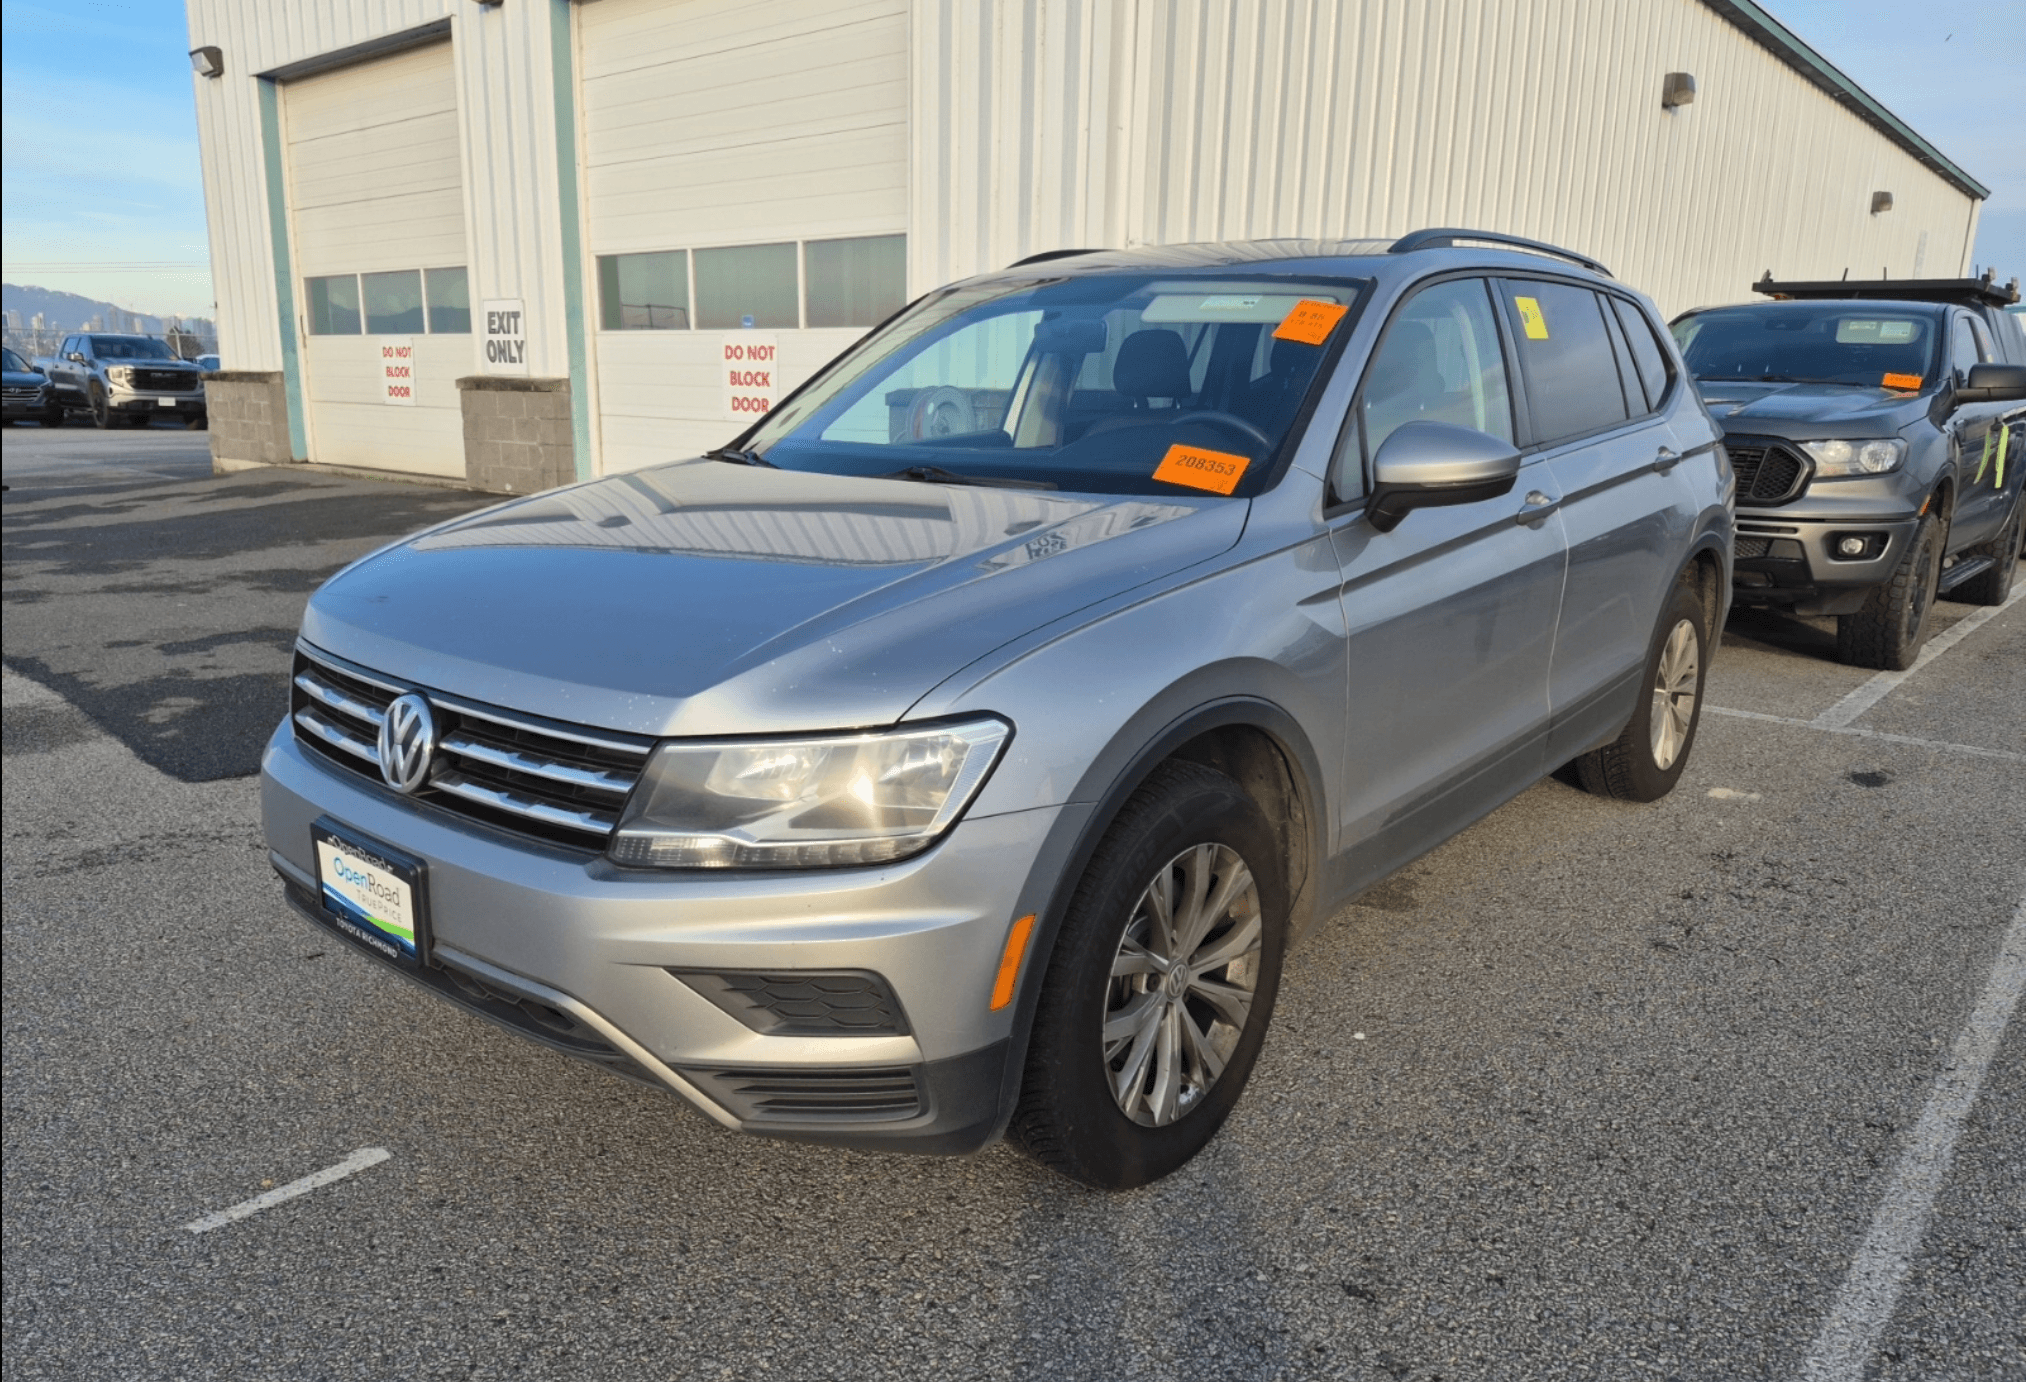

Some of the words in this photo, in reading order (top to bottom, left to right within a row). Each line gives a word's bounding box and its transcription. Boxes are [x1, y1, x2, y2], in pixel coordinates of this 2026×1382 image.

[487, 310, 521, 335] EXIT
[382, 346, 394, 358] DO
[395, 346, 412, 358] NOT
[486, 339, 525, 364] ONLY
[724, 345, 744, 360] DO
[747, 345, 775, 361] NOT
[386, 366, 410, 378] BLOCK
[729, 371, 770, 387] BLOCK
[388, 385, 411, 398] DOOR
[732, 396, 769, 413] DOOR
[1174, 454, 1237, 477] 208353
[333, 857, 401, 908] OpenRoad
[335, 917, 360, 937] TOYOTA
[361, 930, 399, 958] RICHMOND
